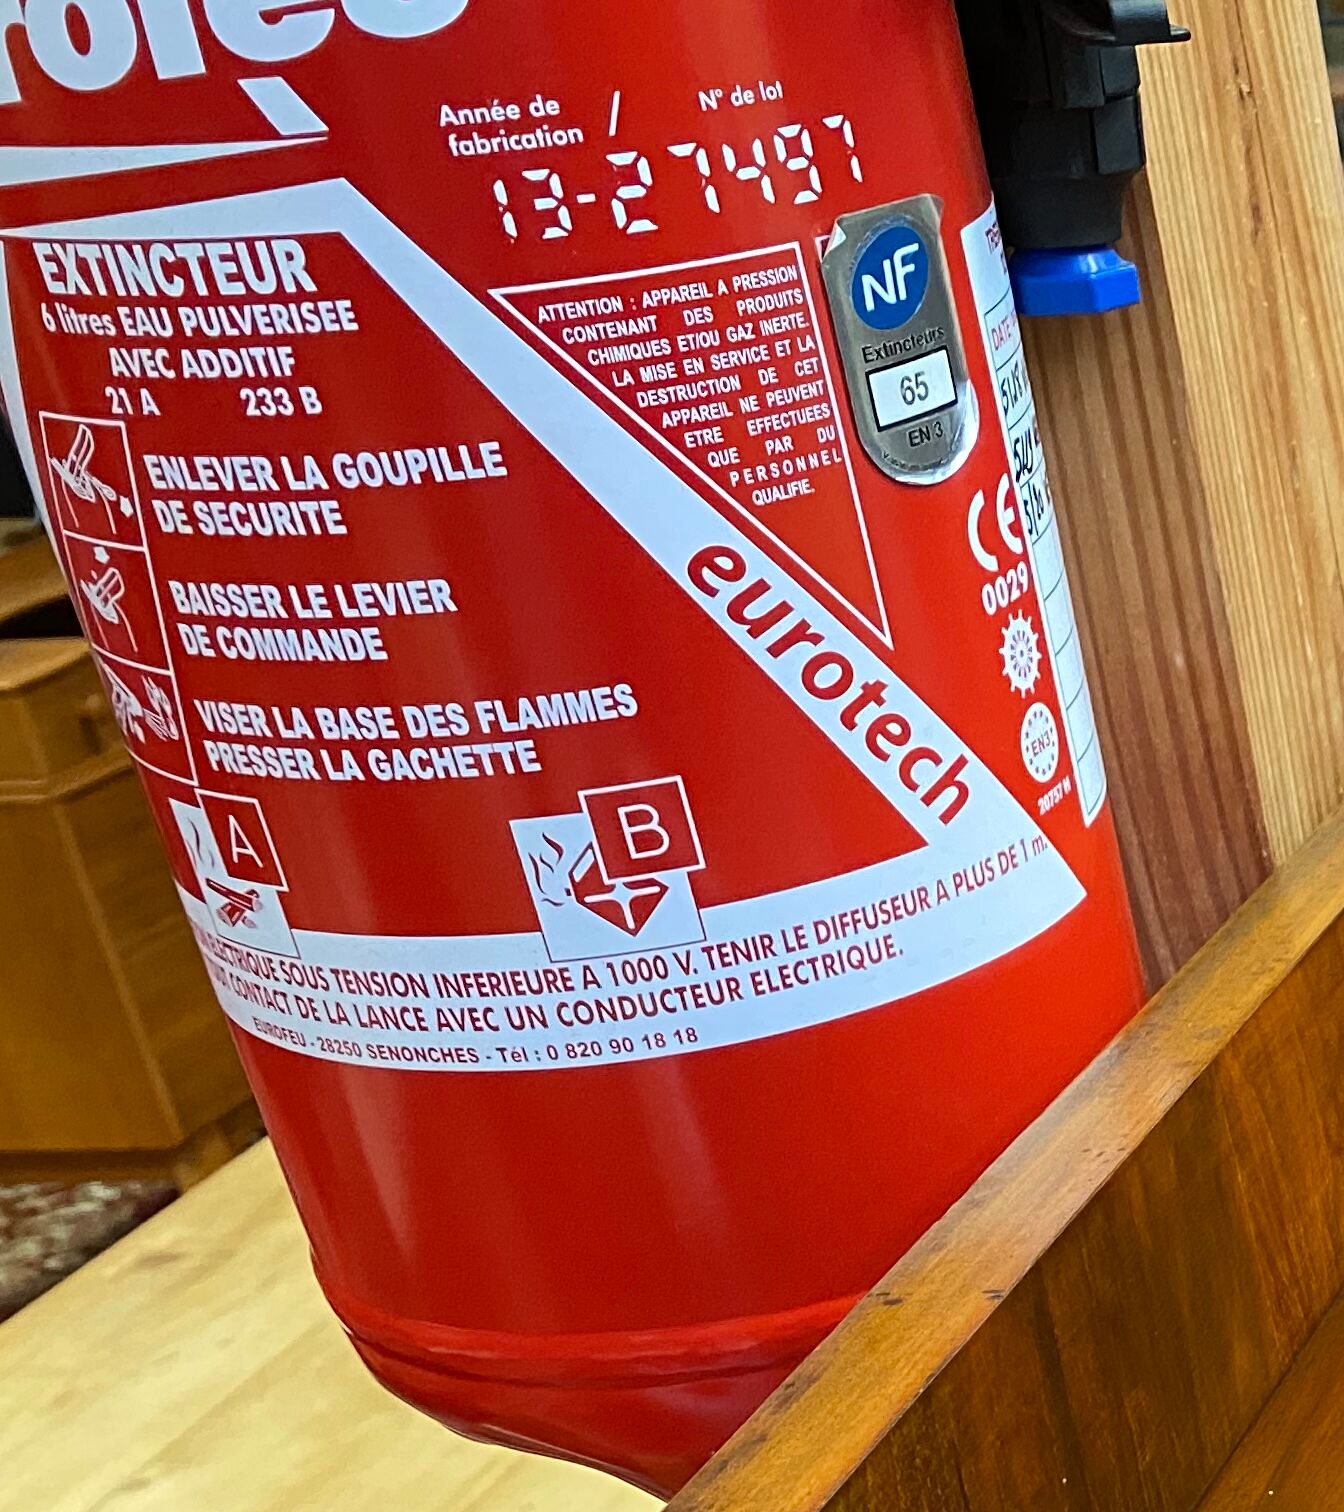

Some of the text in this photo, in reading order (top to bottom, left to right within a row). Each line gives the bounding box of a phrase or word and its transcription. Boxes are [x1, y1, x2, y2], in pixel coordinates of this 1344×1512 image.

[439, 101, 521, 127] Année
[528, 94, 561, 118] de
[731, 85, 754, 107] de
[760, 80, 783, 104] lot
[448, 122, 584, 158] fabrication
[32, 240, 318, 296] EXTINCTEUR
[861, 243, 919, 312] NF
[537, 295, 624, 324] ATTENTION
[642, 285, 713, 309] APPAREIL
[717, 279, 729, 295] A
[732, 264, 798, 293] PRESSION
[562, 287, 804, 345] CONTENANT DES PRODUITS
[42, 300, 359, 337] 6 litres EAU PULVERISEE
[587, 337, 671, 366] CHIMIQUES
[726, 323, 754, 343] GAZ
[761, 311, 810, 337] INERTE.
[109, 346, 295, 379] AVEC ADDITIF
[611, 334, 816, 388] LA MISE EN SERVICE ET LA
[862, 326, 945, 363] Extincteurs
[105, 387, 160, 416] 21 A
[240, 387, 323, 417] 233 B
[636, 357, 820, 408] DESTRUCTION DE CET
[661, 380, 825, 429] APPAREIL NE PEUVENT
[900, 371, 929, 405] 65
[684, 403, 831, 449] ETRE EFFECTUEES
[707, 425, 837, 468] QUE PAR DU
[908, 421, 943, 447] EN 3
[143, 442, 508, 492] ENLEVER LA GOUPILLE
[729, 448, 842, 487] PERSONNEL
[752, 478, 816, 506] QUALIFIE.
[151, 500, 347, 536] DE SECURITE
[168, 579, 458, 619] BAISSER LE LEVIER
[981, 561, 1029, 616] 0029
[178, 623, 388, 662] DE COMMANDE
[686, 544, 972, 826] eurotech
[194, 684, 638, 740] VISER LA BASE DES FLAMMES
[203, 740, 542, 781] PRESSER LA GACHETTE
[1031, 731, 1050, 757] EN3
[227, 815, 263, 869] A
[619, 802, 670, 859] B
[280, 960, 330, 992] SOUS
[330, 966, 429, 998] TENSION
[434, 966, 575, 999] INFERIEURE
[583, 965, 601, 991] A
[606, 954, 670, 988] 1000
[678, 949, 699, 977] V.
[701, 933, 775, 972] TENIR
[780, 925, 808, 954] LE
[812, 886, 931, 944] DIFFUSEUR
[935, 879, 951, 907] A
[953, 857, 996, 898] PLUS
[998, 849, 1019, 878] DE
[1020, 840, 1031, 864] 1
[229, 972, 293, 1016] CONTACT
[293, 994, 322, 1022] DE
[323, 999, 352, 1027] LA
[356, 1001, 429, 1032] LANCE
[436, 1006, 501, 1033] AVEC
[505, 1003, 548, 1031] UN
[556, 976, 744, 1025] CONDUCTEUR
[753, 933, 904, 997] ELECTRIQUE.
[252, 1016, 306, 1047] EUROFEU
[317, 1036, 363, 1059] 28250
[365, 1044, 480, 1064] SENONCHES
[546, 1044, 559, 1062] 0
[566, 1040, 602, 1059] 820
[608, 1037, 634, 1055] 90
[642, 1032, 666, 1050] 18
[674, 1027, 698, 1045] 18
